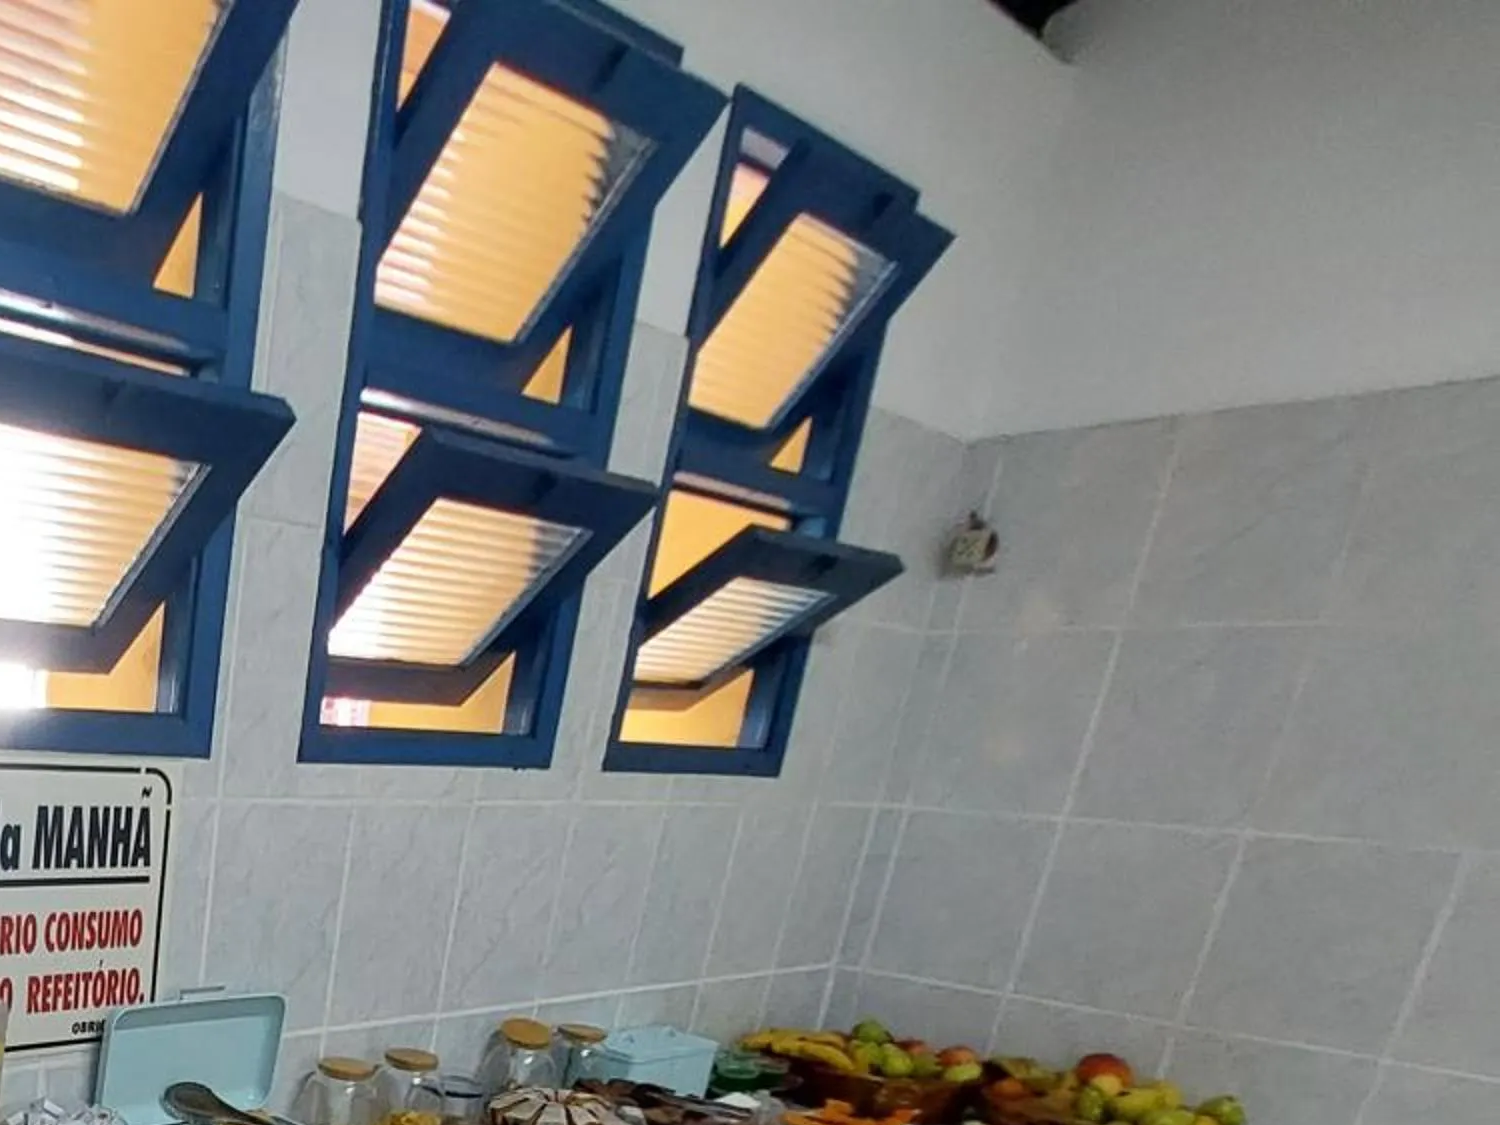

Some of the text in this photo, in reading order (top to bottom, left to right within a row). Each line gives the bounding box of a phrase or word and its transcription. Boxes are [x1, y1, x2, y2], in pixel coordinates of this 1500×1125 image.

[31, 786, 152, 870] MANHÃ
[44, 909, 143, 954] CONSUMO
[26, 960, 145, 1014] REFEITÓRIO.
